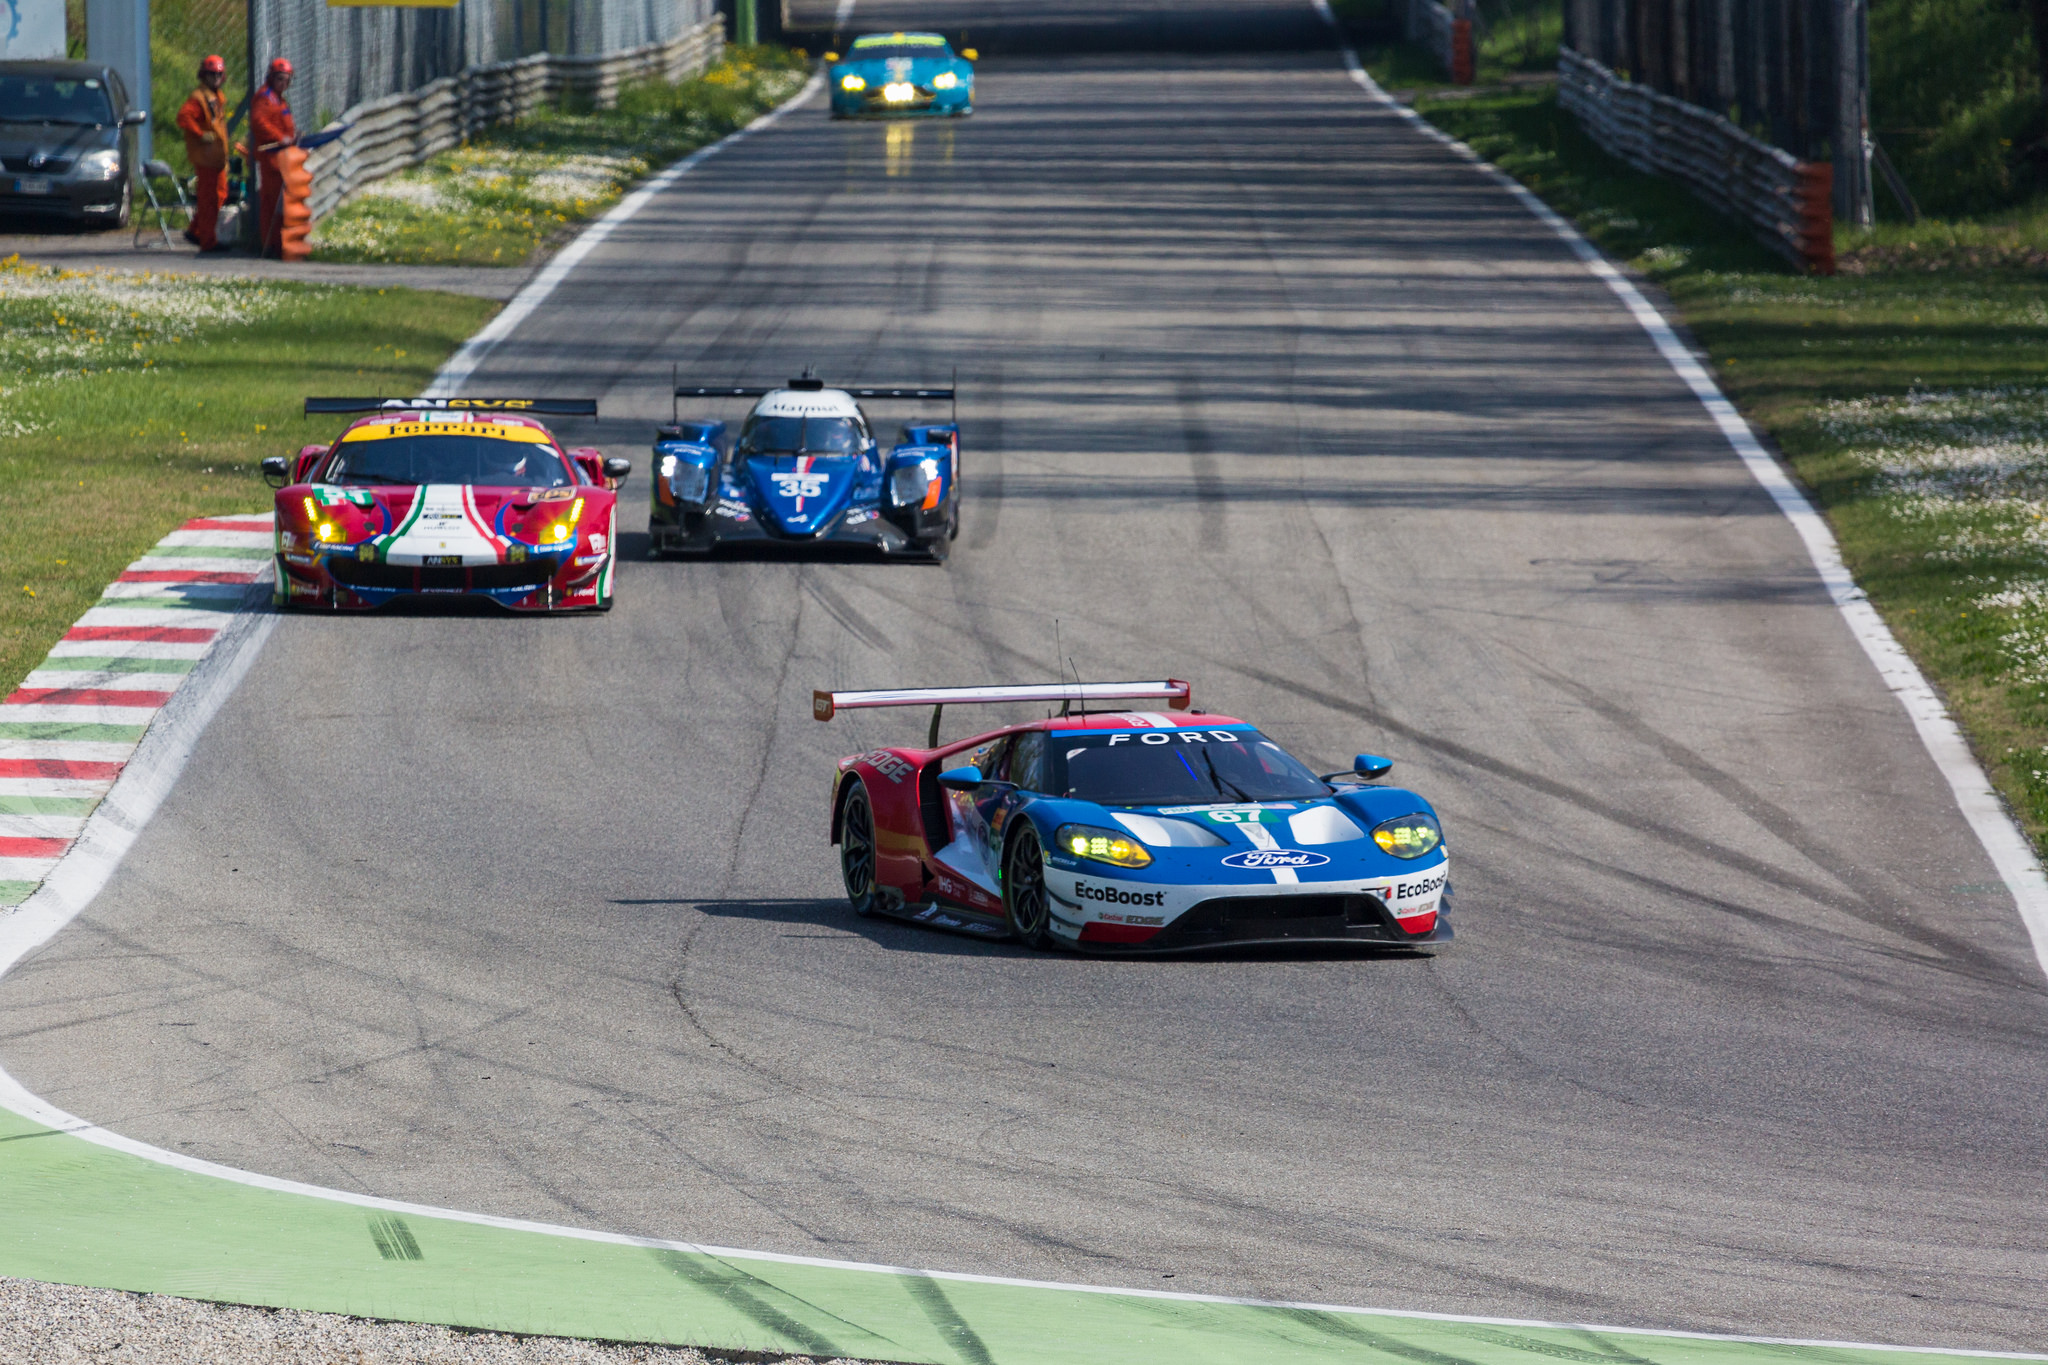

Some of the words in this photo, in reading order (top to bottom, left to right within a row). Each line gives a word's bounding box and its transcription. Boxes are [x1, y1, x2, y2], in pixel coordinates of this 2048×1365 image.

[389, 424, 506, 436] Ferrari
[778, 479, 822, 498] 35
[1108, 730, 1239, 747] FORD
[866, 749, 915, 785] EDGE
[1207, 808, 1262, 823] 67
[1243, 851, 1310, 867] Ford
[1074, 881, 1165, 907] EcoBoost
[1126, 914, 1165, 926] EDGE
